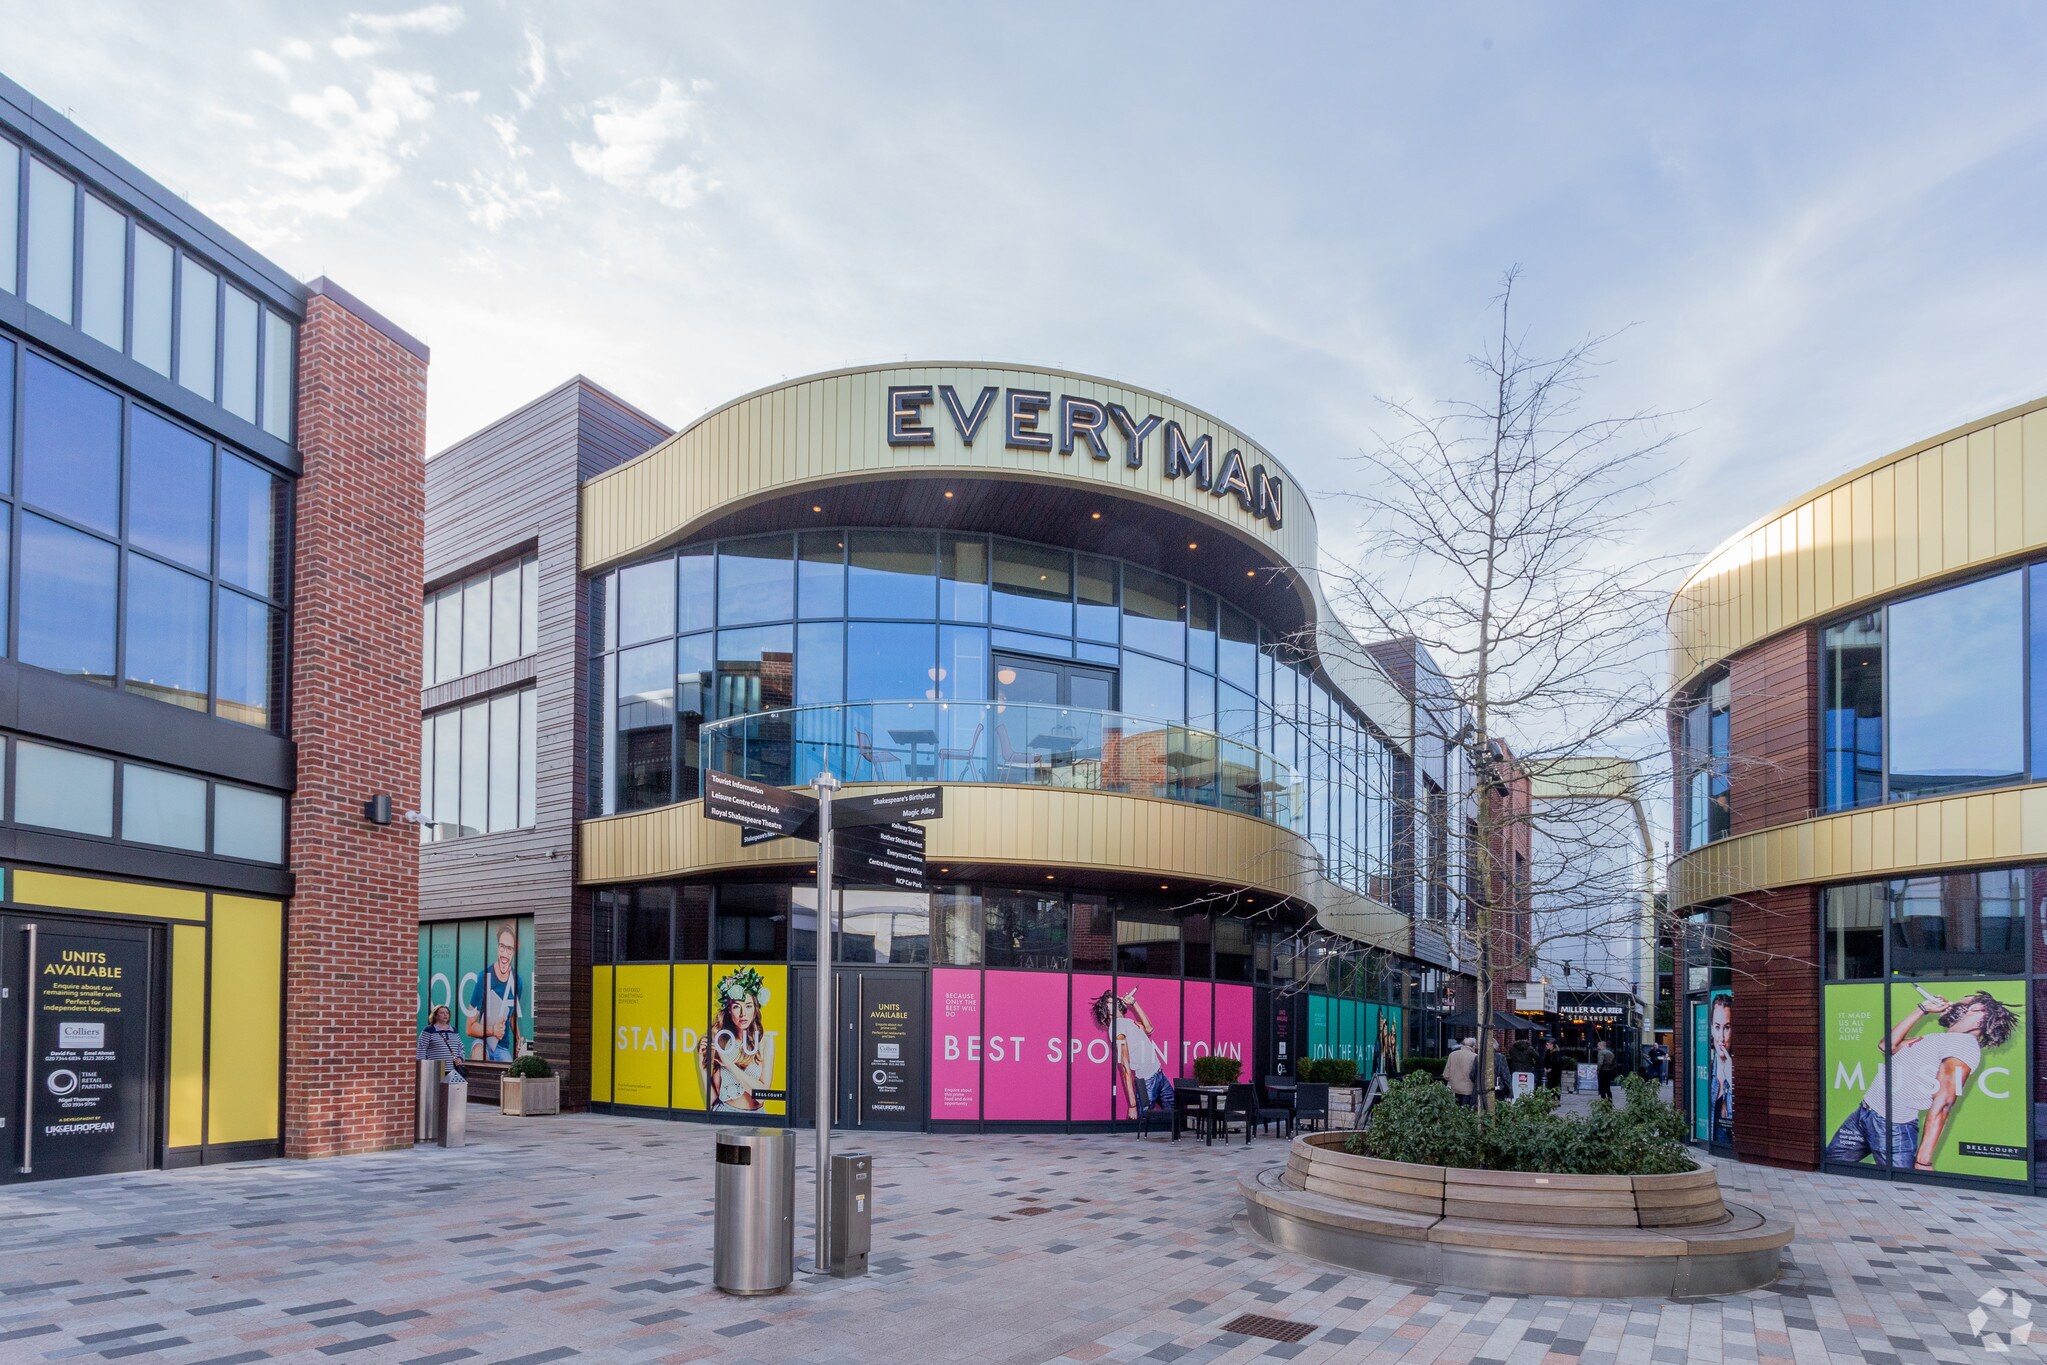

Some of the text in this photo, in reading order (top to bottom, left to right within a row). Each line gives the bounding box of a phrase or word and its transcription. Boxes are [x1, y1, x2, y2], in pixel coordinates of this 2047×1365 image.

[886, 384, 1283, 531] EVERYMAN
[711, 774, 764, 795] Tourist Information
[711, 790, 780, 814] Leisure Centre Coach Park
[872, 792, 936, 806] Shakespeare's Birthplace
[711, 807, 783, 830] Royal Shakespeare Theatre
[902, 807, 936, 818] Magic Alley
[891, 822, 923, 835] Railway Station
[880, 832, 923, 849] Rother Street Market
[886, 848, 923, 863] Everyman Cinema
[868, 857, 923, 876] Centre Management Office
[895, 877, 923, 889] NCP Car Park
[62, 950, 106, 964] UNITS
[43, 963, 122, 978] AVAILABLE
[53, 982, 80, 991] Enquire
[80, 983, 101, 991] about
[43, 989, 79, 998] remaining
[945, 992, 975, 1000] BECAUSE
[43, 1004, 87, 1012] independent
[878, 1003, 900, 1011] UNITS
[1560, 1006, 1589, 1014] MILLER
[1596, 1006, 1623, 1014] CARTER
[870, 1011, 908, 1019] AVAILABLE
[1568, 1014, 1617, 1022] STEAKHOUSE
[1848, 1011, 1871, 1019] MADE
[1838, 1019, 1865, 1027] US ALL
[64, 1027, 100, 1036] Colliers
[1838, 1026, 1864, 1034] COME
[617, 1026, 778, 1056] STAND OUT
[944, 1034, 1025, 1062] BEST
[1047, 1037, 1127, 1064] SPOT
[1183, 1040, 1241, 1064] TOWN
[1312, 1043, 1334, 1062] JOIN
[1355, 1044, 1375, 1061] PATY
[1989, 1146, 2019, 1154] COURT
